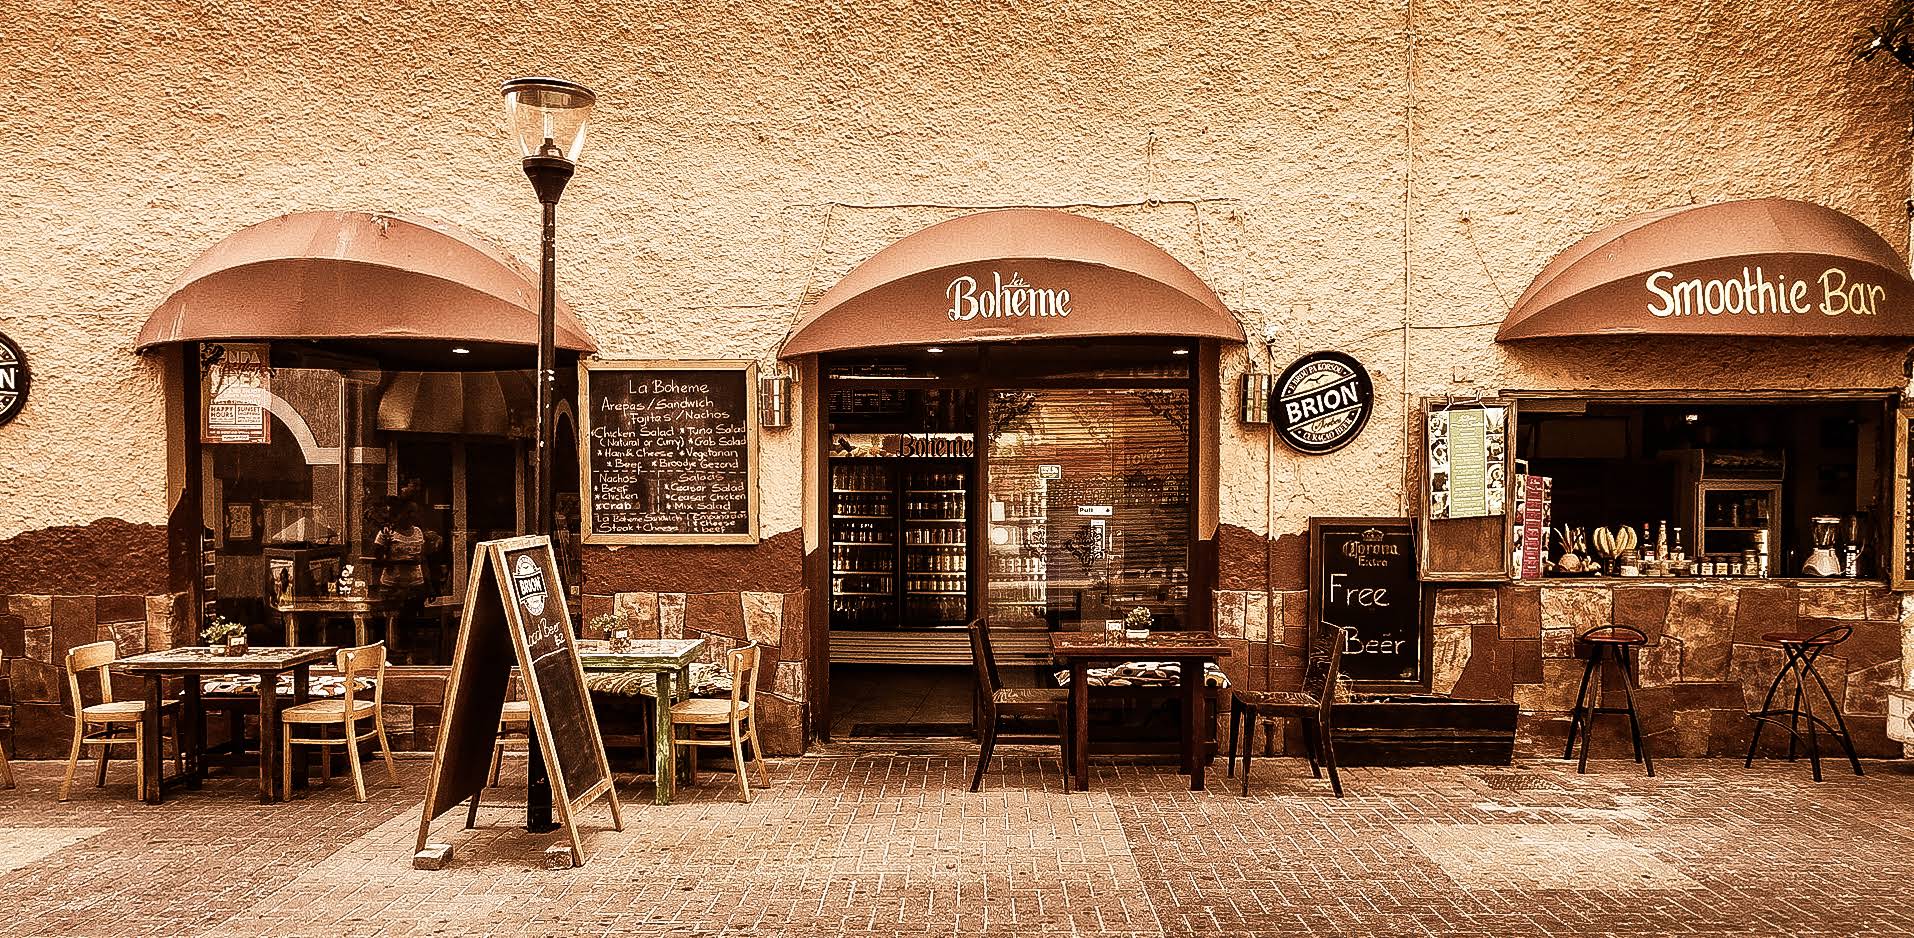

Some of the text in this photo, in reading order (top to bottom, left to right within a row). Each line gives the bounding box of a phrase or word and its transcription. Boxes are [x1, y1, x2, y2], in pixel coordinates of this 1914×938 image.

[1646, 266, 1886, 317] Smoothie Bar
[629, 378, 710, 394] La Boheme
[602, 396, 646, 417] Arepas
[1285, 381, 1358, 424] BRION
[639, 425, 675, 437] Salad
[686, 420, 746, 436] Tuna Salad
[643, 439, 653, 447] or
[694, 434, 747, 446] Crab Salad
[635, 447, 674, 458] Cheese
[685, 446, 739, 461] Vegetarian
[614, 458, 642, 475] Beef
[659, 458, 739, 470] Broodje Gezond
[599, 472, 638, 483] Nachos
[678, 472, 725, 483] Salads
[601, 483, 629, 494] Beef
[711, 481, 745, 493] Salad
[709, 492, 747, 501] Chicken
[674, 501, 731, 510] Mix Salad
[1342, 540, 1400, 559] Corona
[1358, 555, 1388, 567] Extra
[1330, 573, 1390, 607] Free
